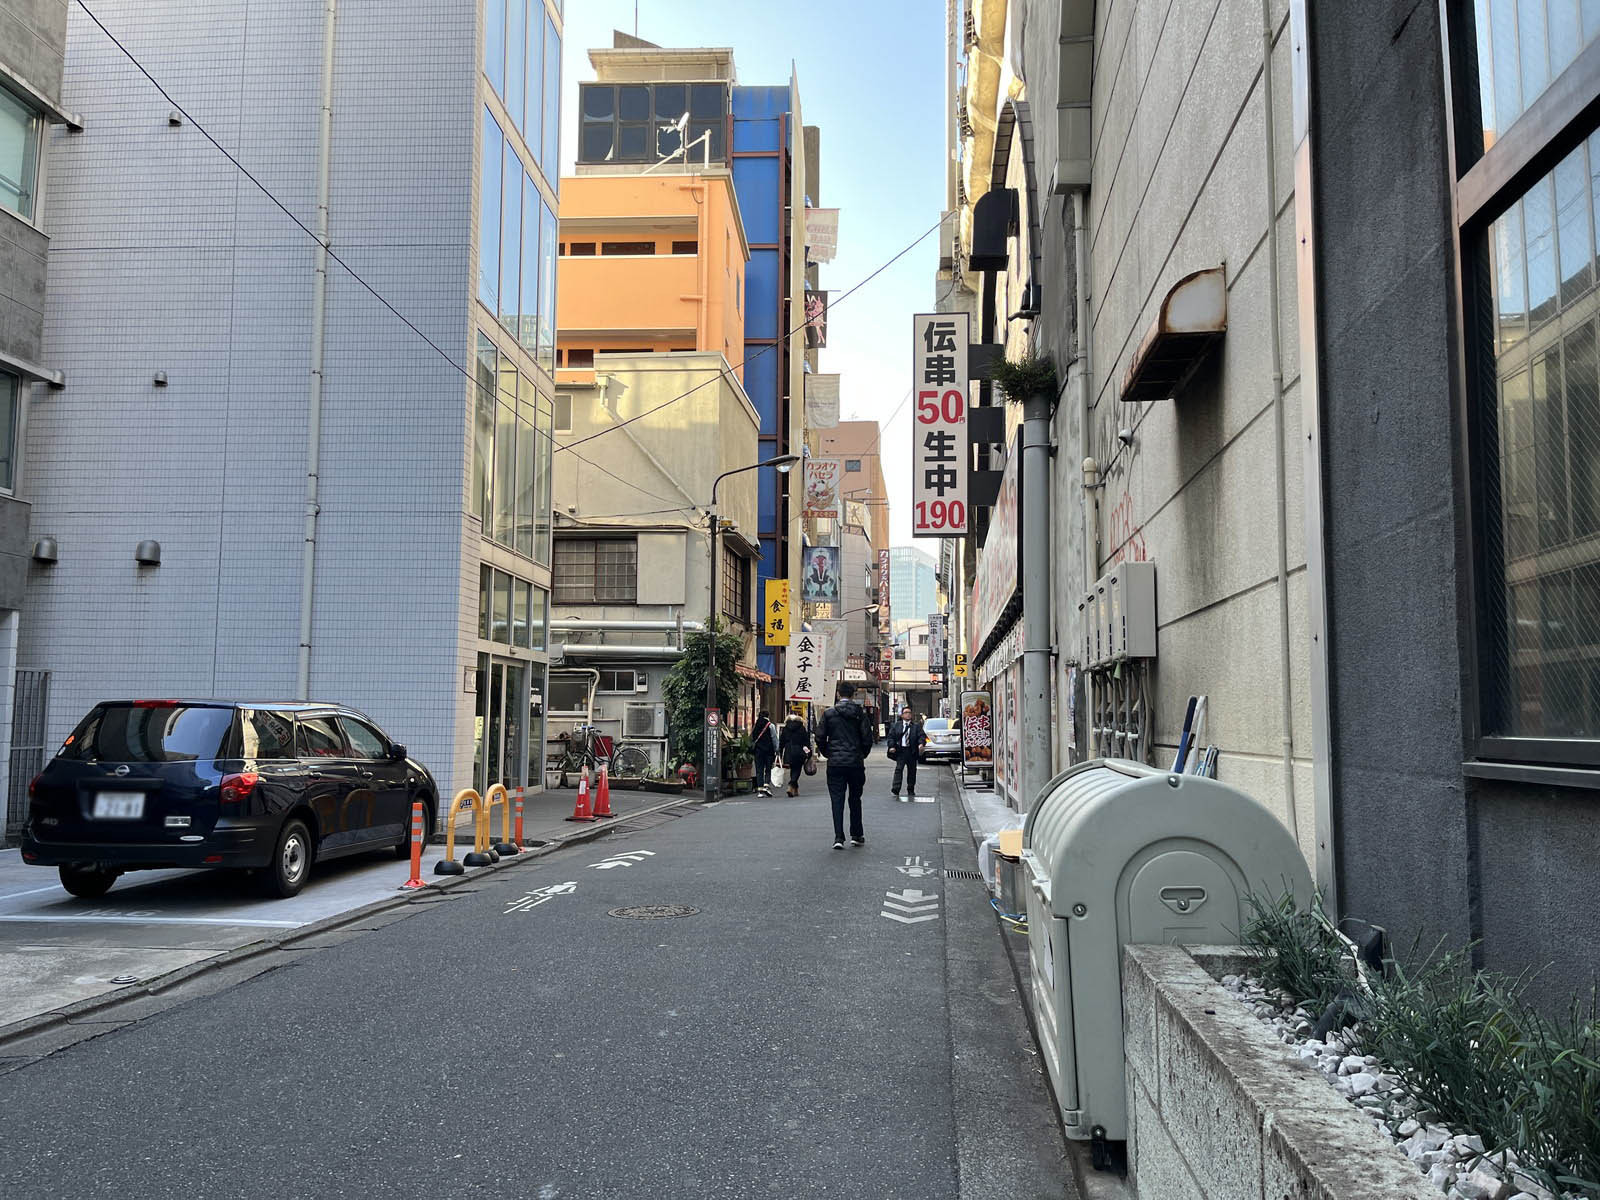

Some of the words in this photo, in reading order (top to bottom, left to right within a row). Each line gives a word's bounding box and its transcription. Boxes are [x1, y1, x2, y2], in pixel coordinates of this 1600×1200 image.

[923, 321, 957, 386] 伝串
[923, 430, 957, 497] 生中
[795, 635, 815, 693] 金子屋
[956, 655, 964, 665] P
[964, 715, 990, 731] 伝串
